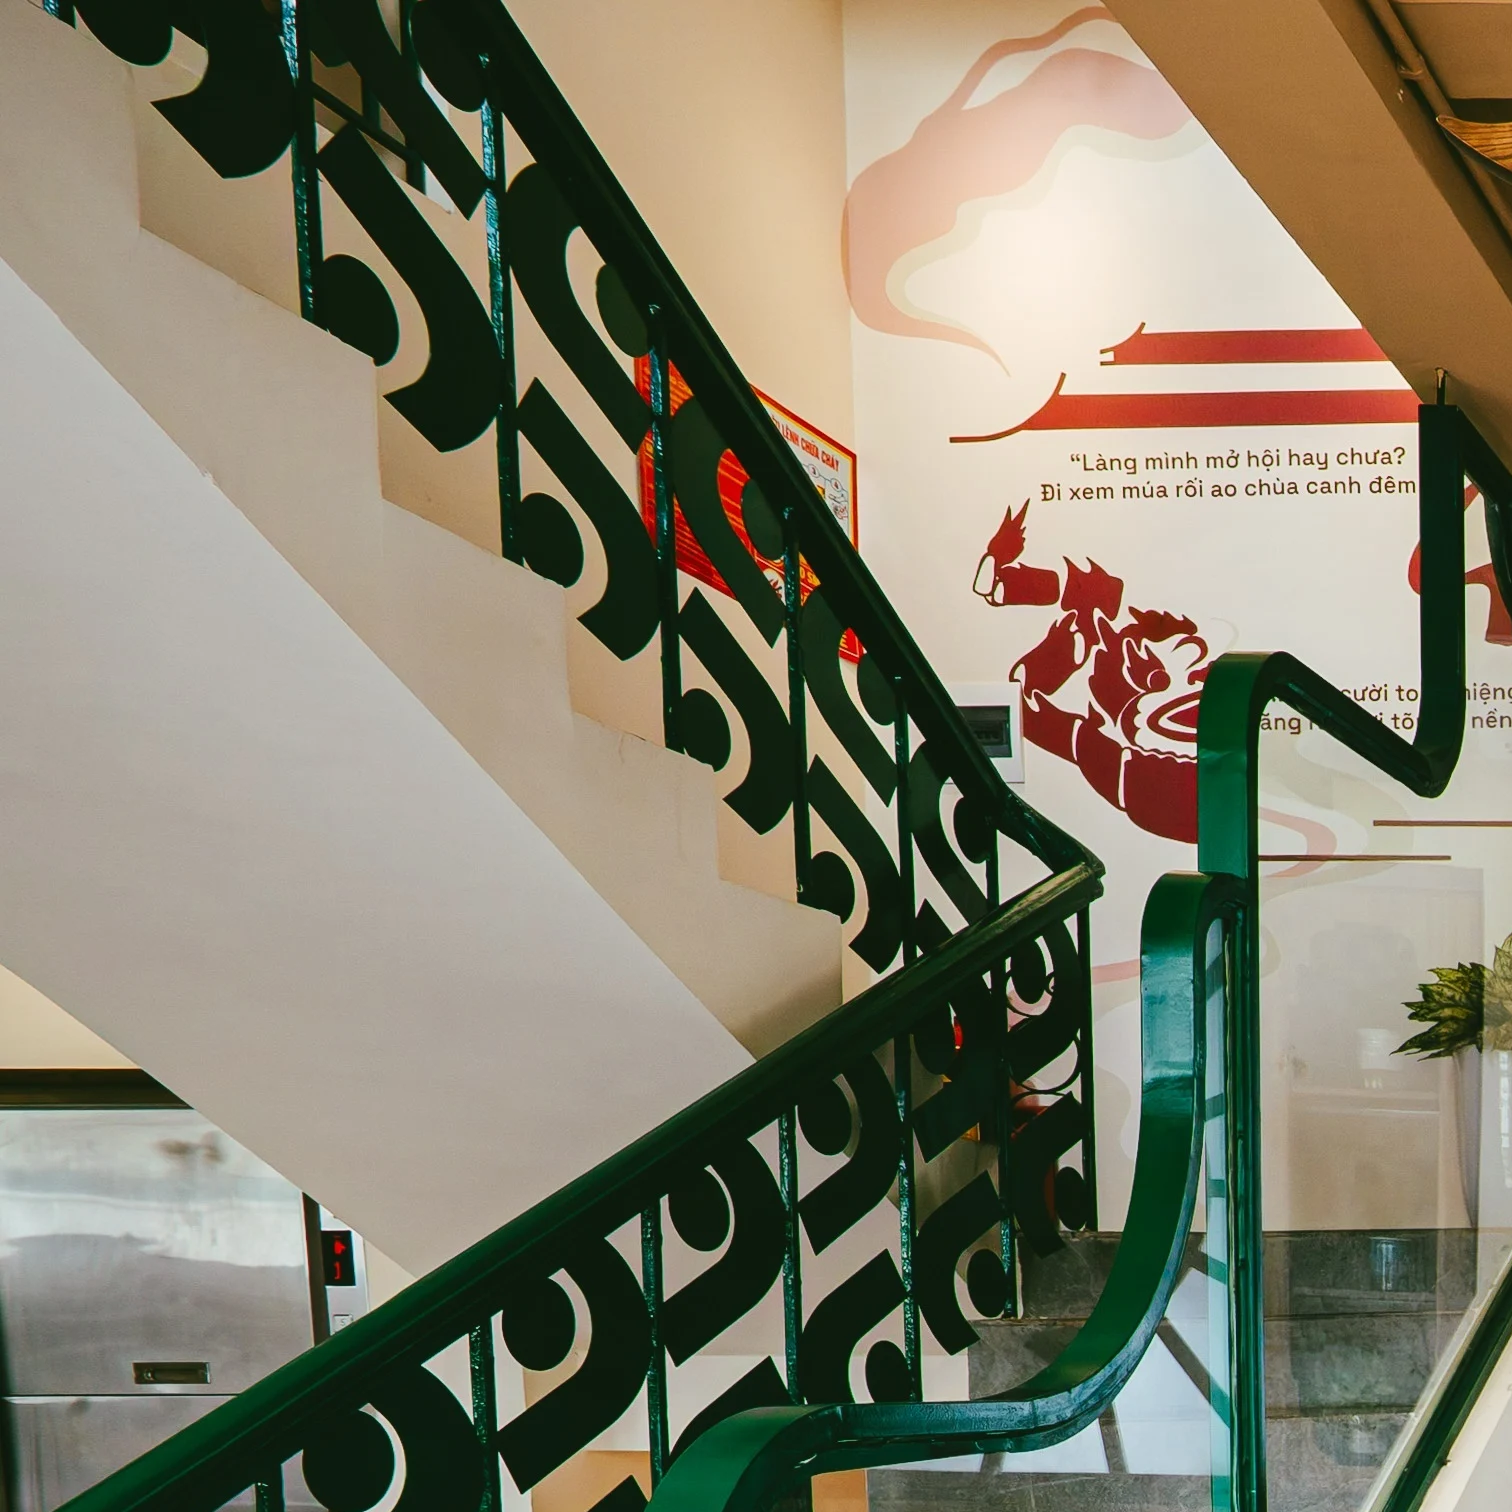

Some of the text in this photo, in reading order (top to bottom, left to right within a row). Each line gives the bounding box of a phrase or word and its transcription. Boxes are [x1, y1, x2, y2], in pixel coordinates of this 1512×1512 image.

[1145, 452, 1198, 470] mình
[1206, 449, 1240, 469] mở
[1247, 449, 1280, 472] hội
[1288, 449, 1328, 470] hay
[1336, 446, 1406, 466] chưa?
[1041, 476, 1416, 501] Đi xem múa rối ao chùa canh đêm
